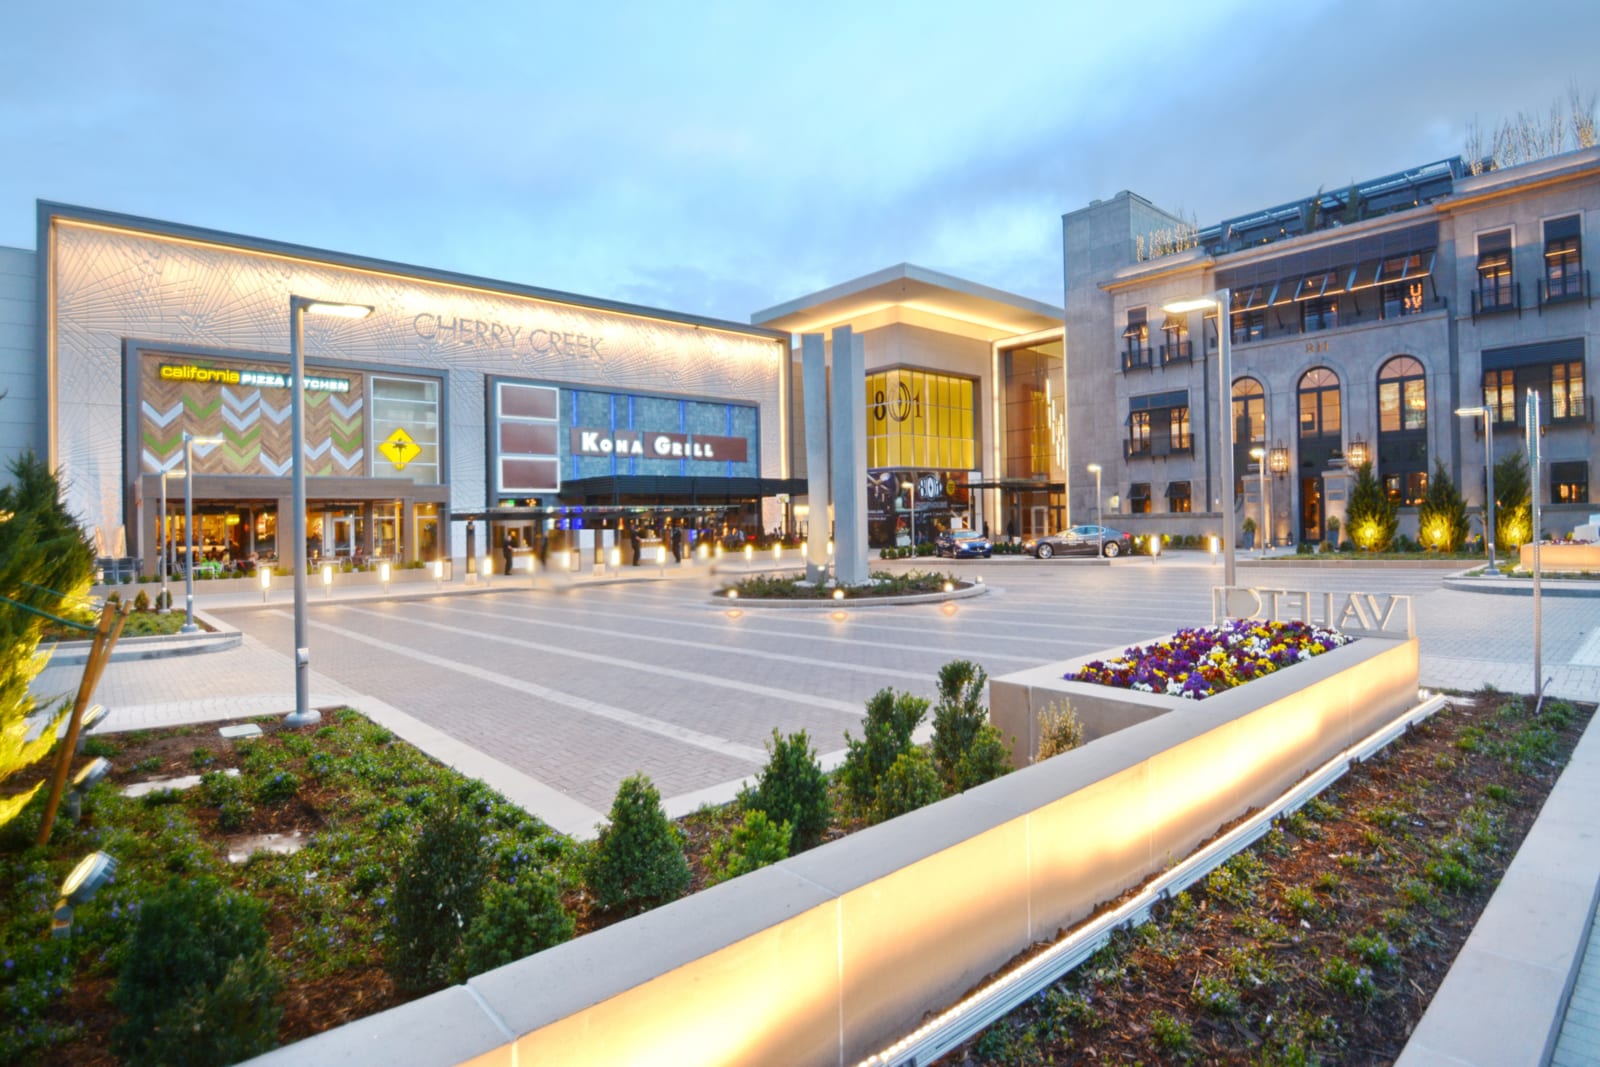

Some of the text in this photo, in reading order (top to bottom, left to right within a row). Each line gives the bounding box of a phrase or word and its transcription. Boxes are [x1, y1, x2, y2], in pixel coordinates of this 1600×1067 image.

[413, 313, 605, 361] CHERRY CREEK
[160, 365, 350, 393] california PIZZA TCHEN
[874, 381, 923, 422] 801
